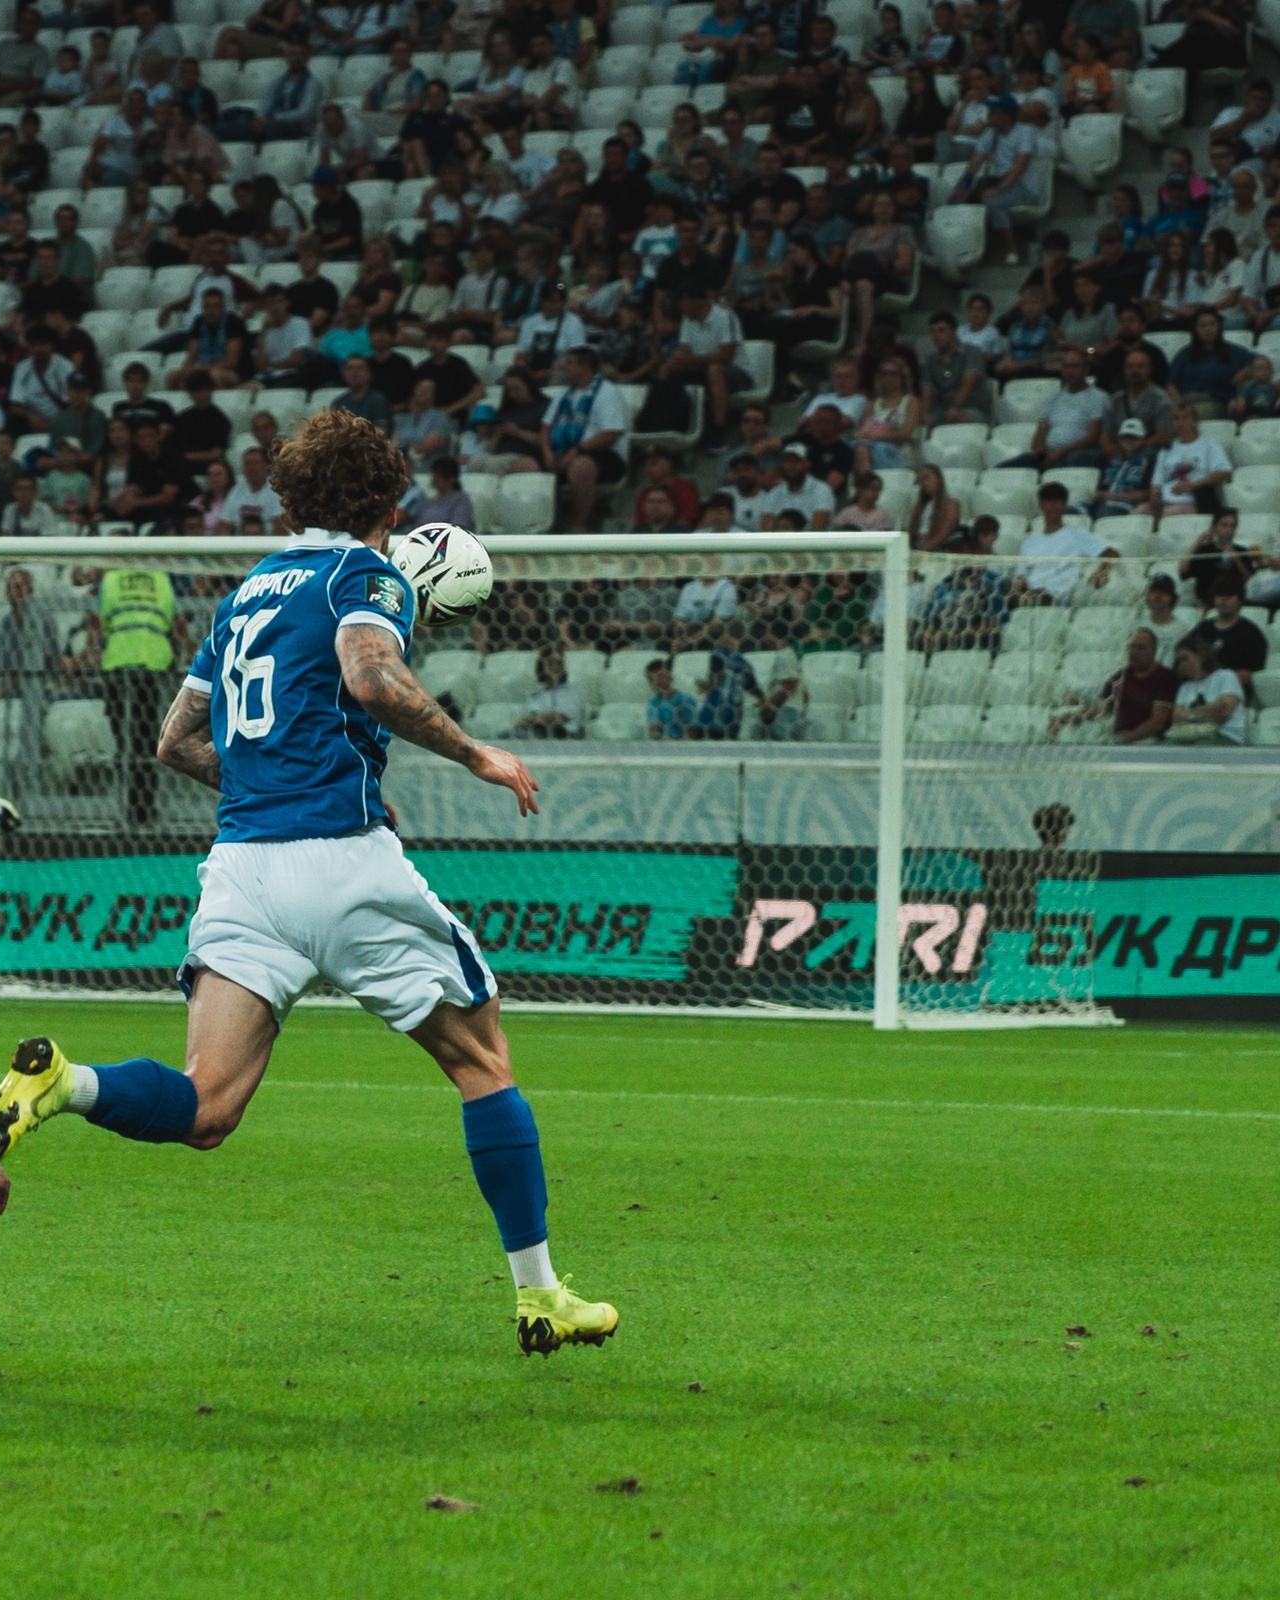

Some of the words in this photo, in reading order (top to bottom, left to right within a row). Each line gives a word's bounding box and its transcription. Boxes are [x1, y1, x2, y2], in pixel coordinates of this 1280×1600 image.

[455, 566, 487, 579] DEMIX
[221, 605, 282, 748] 16
[93, 895, 199, 951] ДР
[735, 899, 987, 974] PARI
[1026, 913, 1172, 969] БУК
[1169, 917, 1280, 978] ДР
